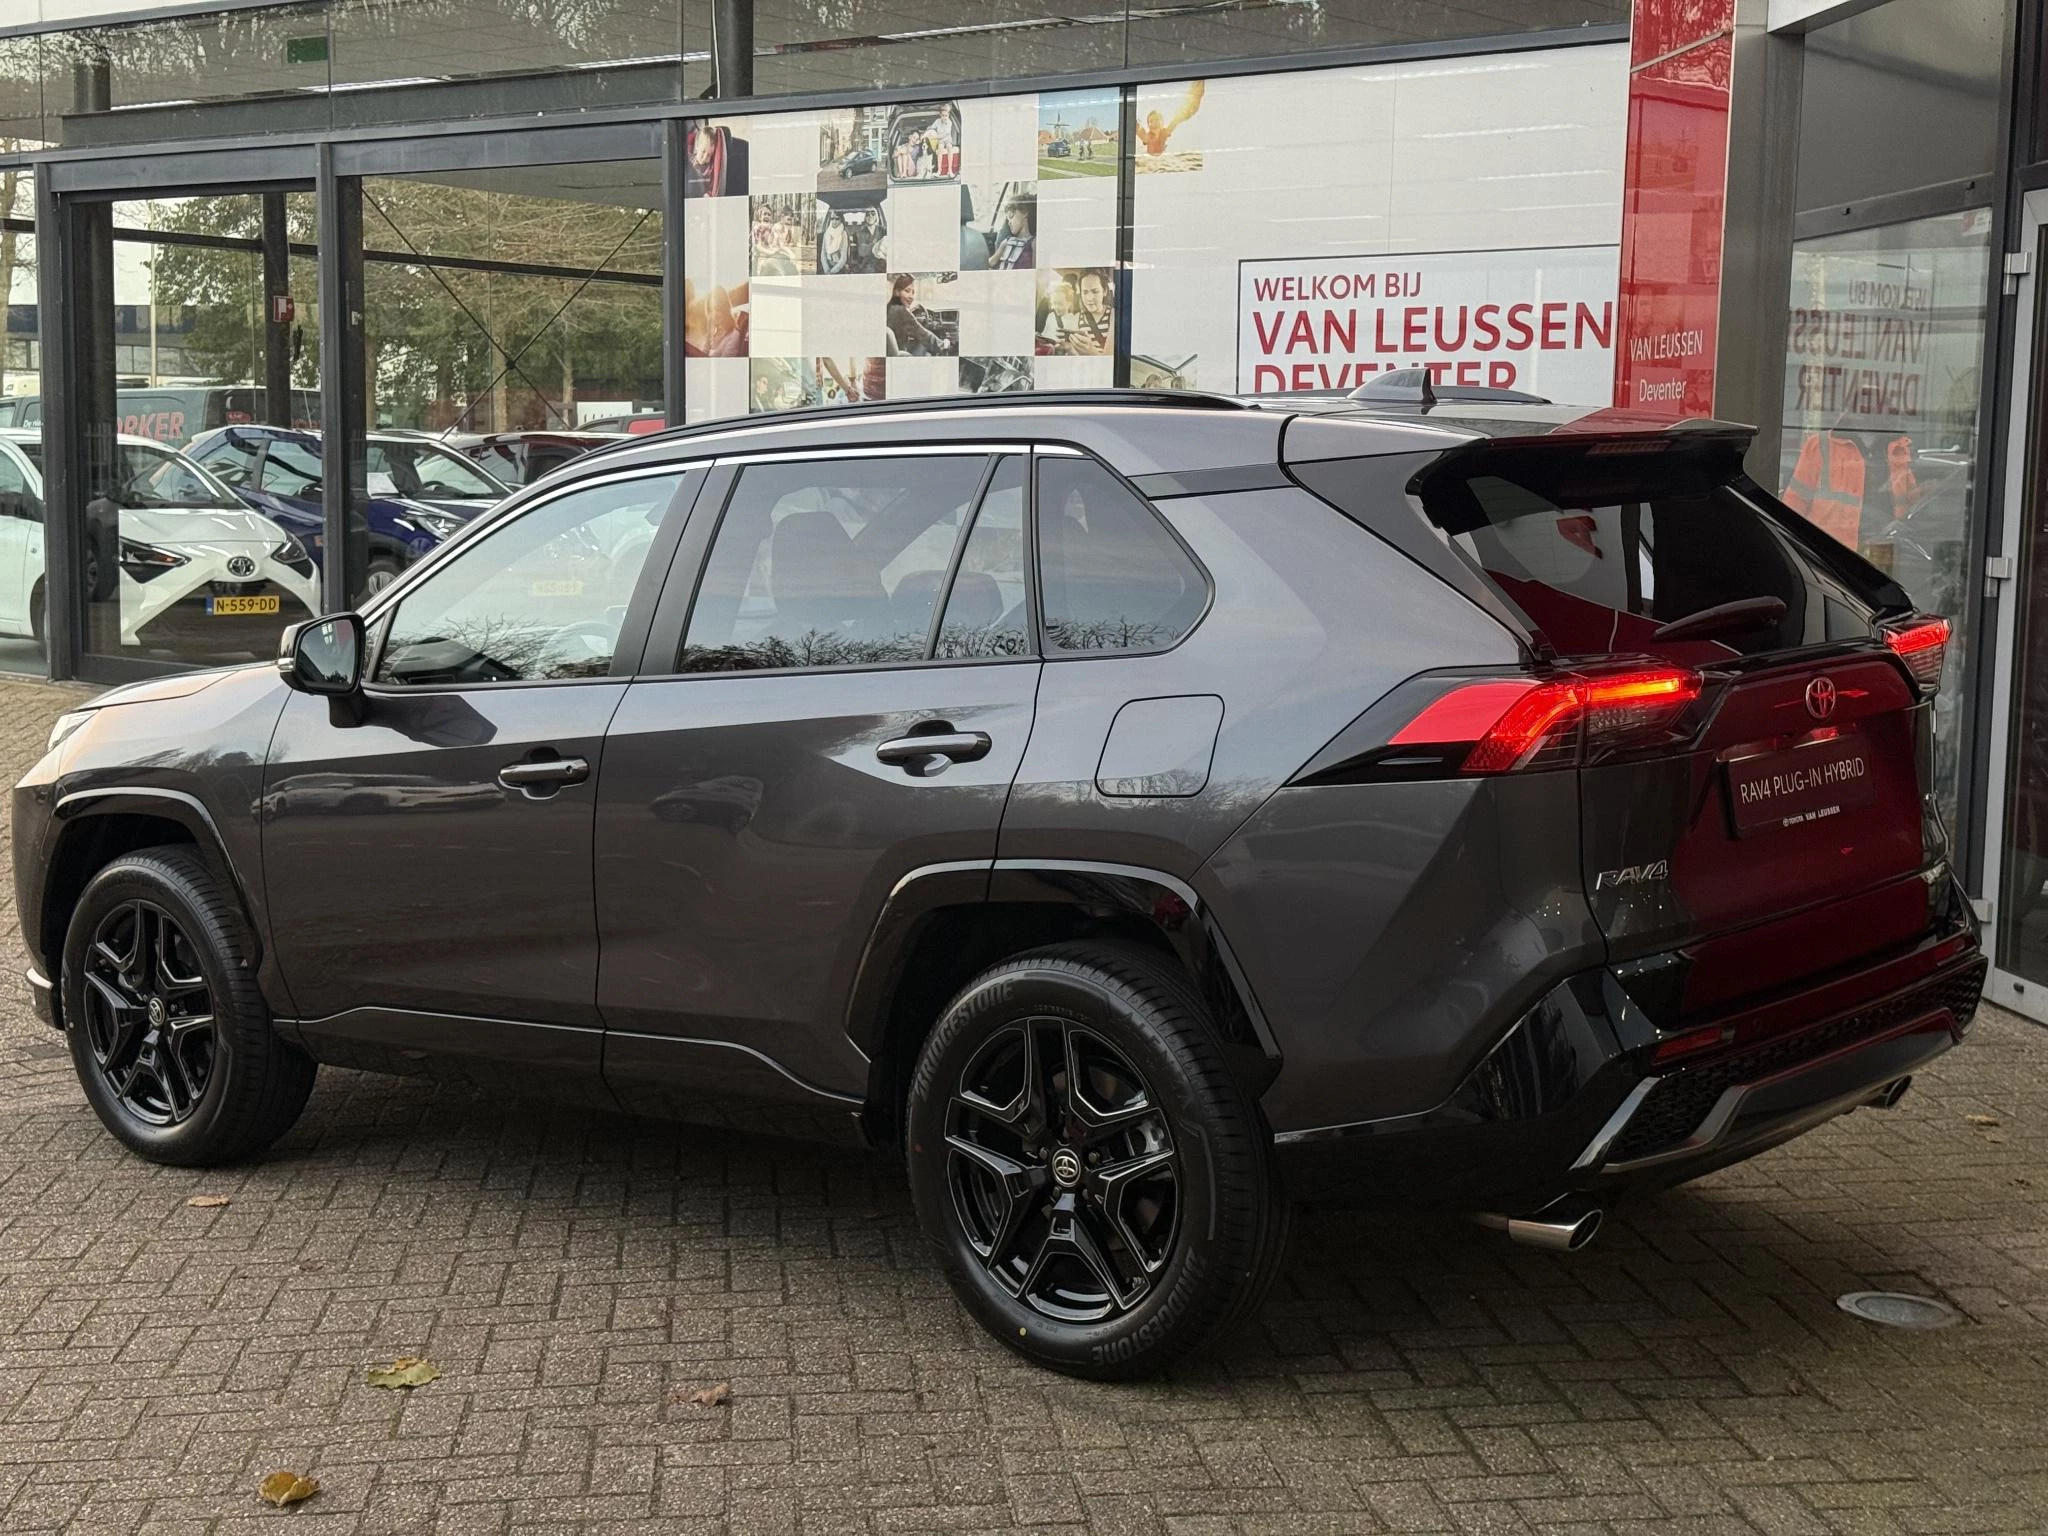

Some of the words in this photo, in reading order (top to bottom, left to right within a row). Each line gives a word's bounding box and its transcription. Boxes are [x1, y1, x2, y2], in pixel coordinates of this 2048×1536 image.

[1254, 273, 1376, 302] WELKOM
[1385, 271, 1422, 298] BIJ
[1252, 308, 1357, 355] VAN
[1375, 300, 1613, 353] LEUSSEN
[1630, 335, 1652, 362] VAN
[1654, 329, 1703, 360] LEUSSEN
[1254, 361, 1517, 393] DEVETER
[1639, 377, 1687, 402] Deventer
[215, 598, 277, 613] N-559-DD
[1740, 777, 1772, 804] RAV4
[1773, 765, 1823, 796] PLUG-IN
[1824, 756, 1865, 784] HYBRID
[1595, 859, 1669, 891] RAV4
[912, 978, 1015, 1104] BRIDGESTONE
